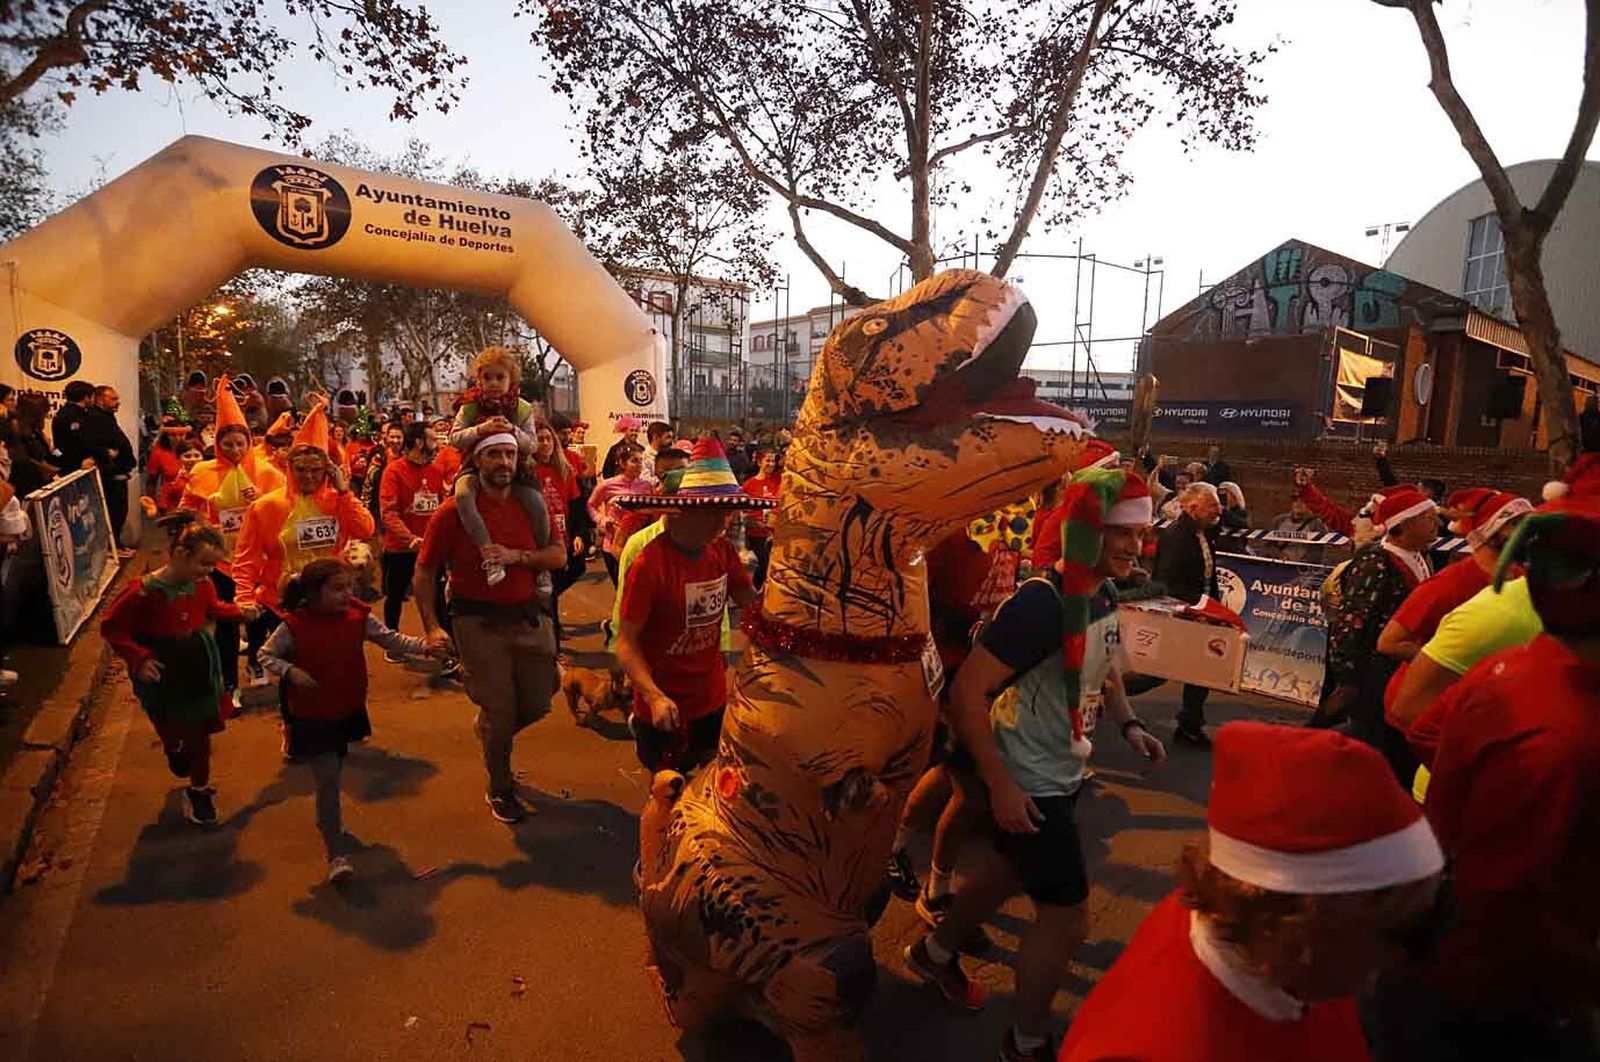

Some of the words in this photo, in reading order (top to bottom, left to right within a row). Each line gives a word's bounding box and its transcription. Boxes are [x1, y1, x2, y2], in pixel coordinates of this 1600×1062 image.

[356, 183, 512, 221] Ayuntamiento
[403, 209, 431, 227] de
[438, 213, 512, 239] Huelva
[439, 234, 456, 246] de
[459, 236, 514, 254] Deportes
[1089, 407, 1128, 416] HYUNDAI
[1164, 407, 1209, 418] HYUNDAI
[1240, 407, 1292, 419] HYUNDAI
[1281, 598, 1303, 611] de
